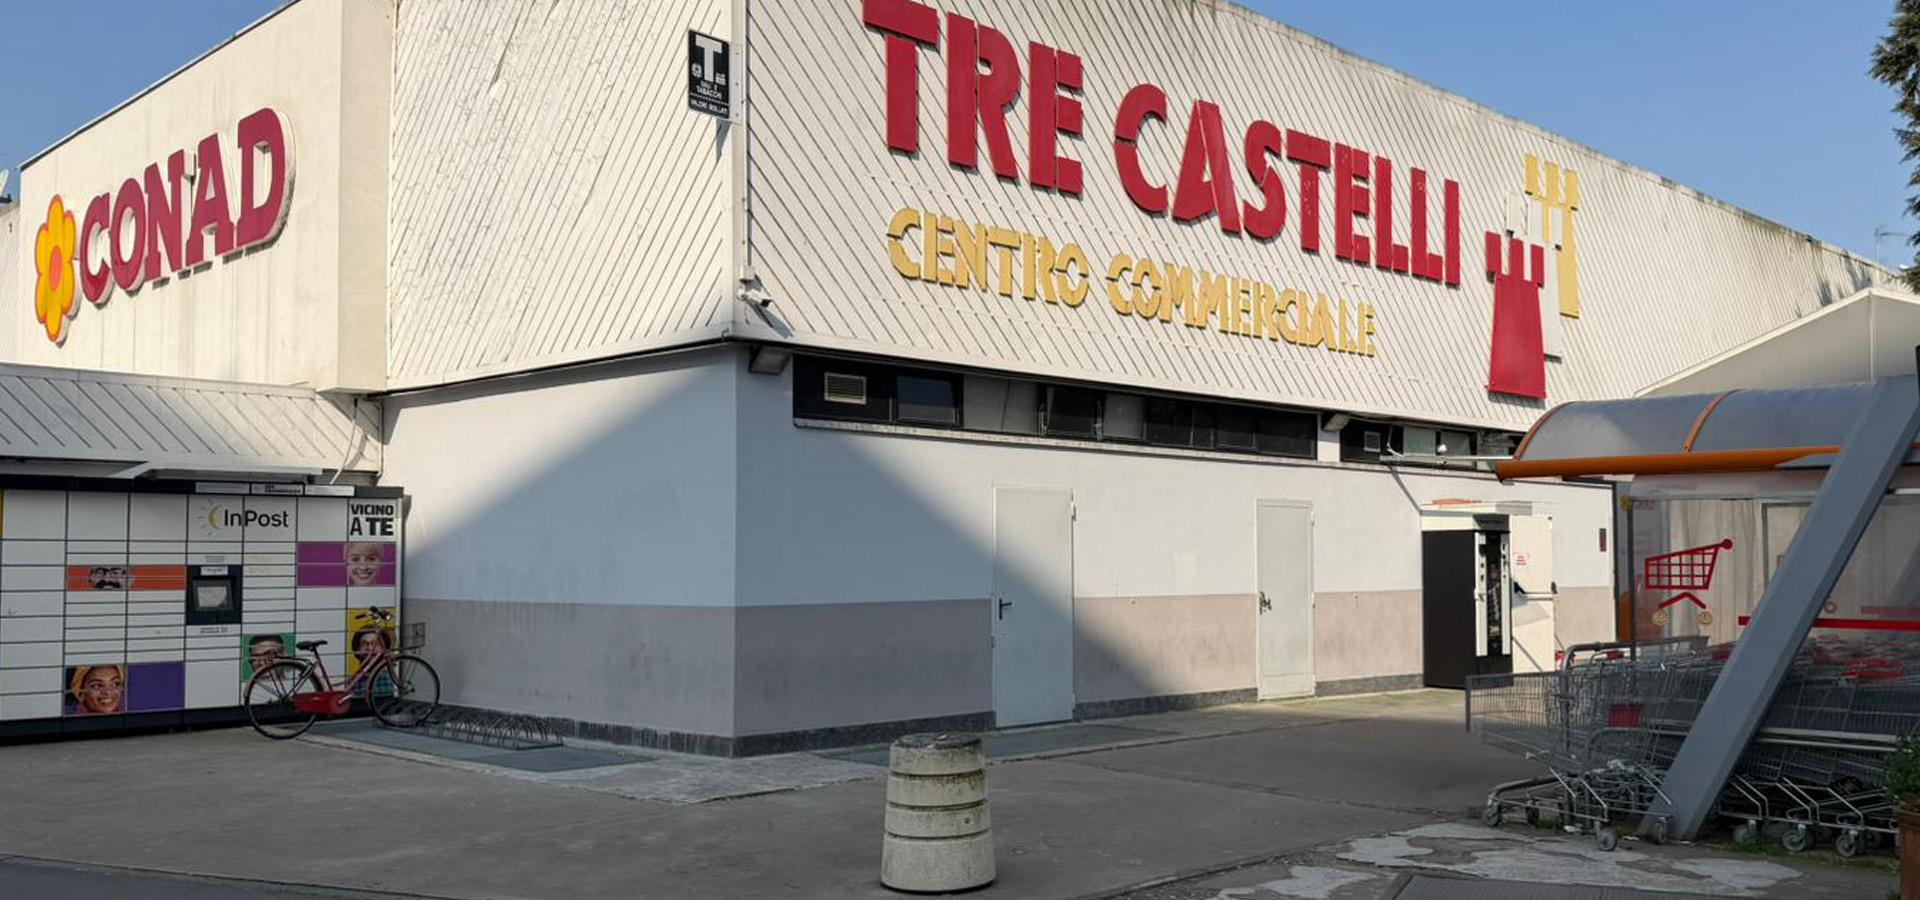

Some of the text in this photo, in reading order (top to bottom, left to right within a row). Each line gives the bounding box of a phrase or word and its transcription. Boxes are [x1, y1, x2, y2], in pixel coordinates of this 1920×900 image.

[695, 33, 723, 84] T
[863, 0, 1461, 287] TRE CASTELLI
[80, 107, 288, 304] CONAD
[886, 207, 1376, 356] CENTRO COMMERCIALE
[223, 508, 290, 528] InPost
[350, 503, 395, 516] VICINO
[350, 516, 395, 537] A TE
